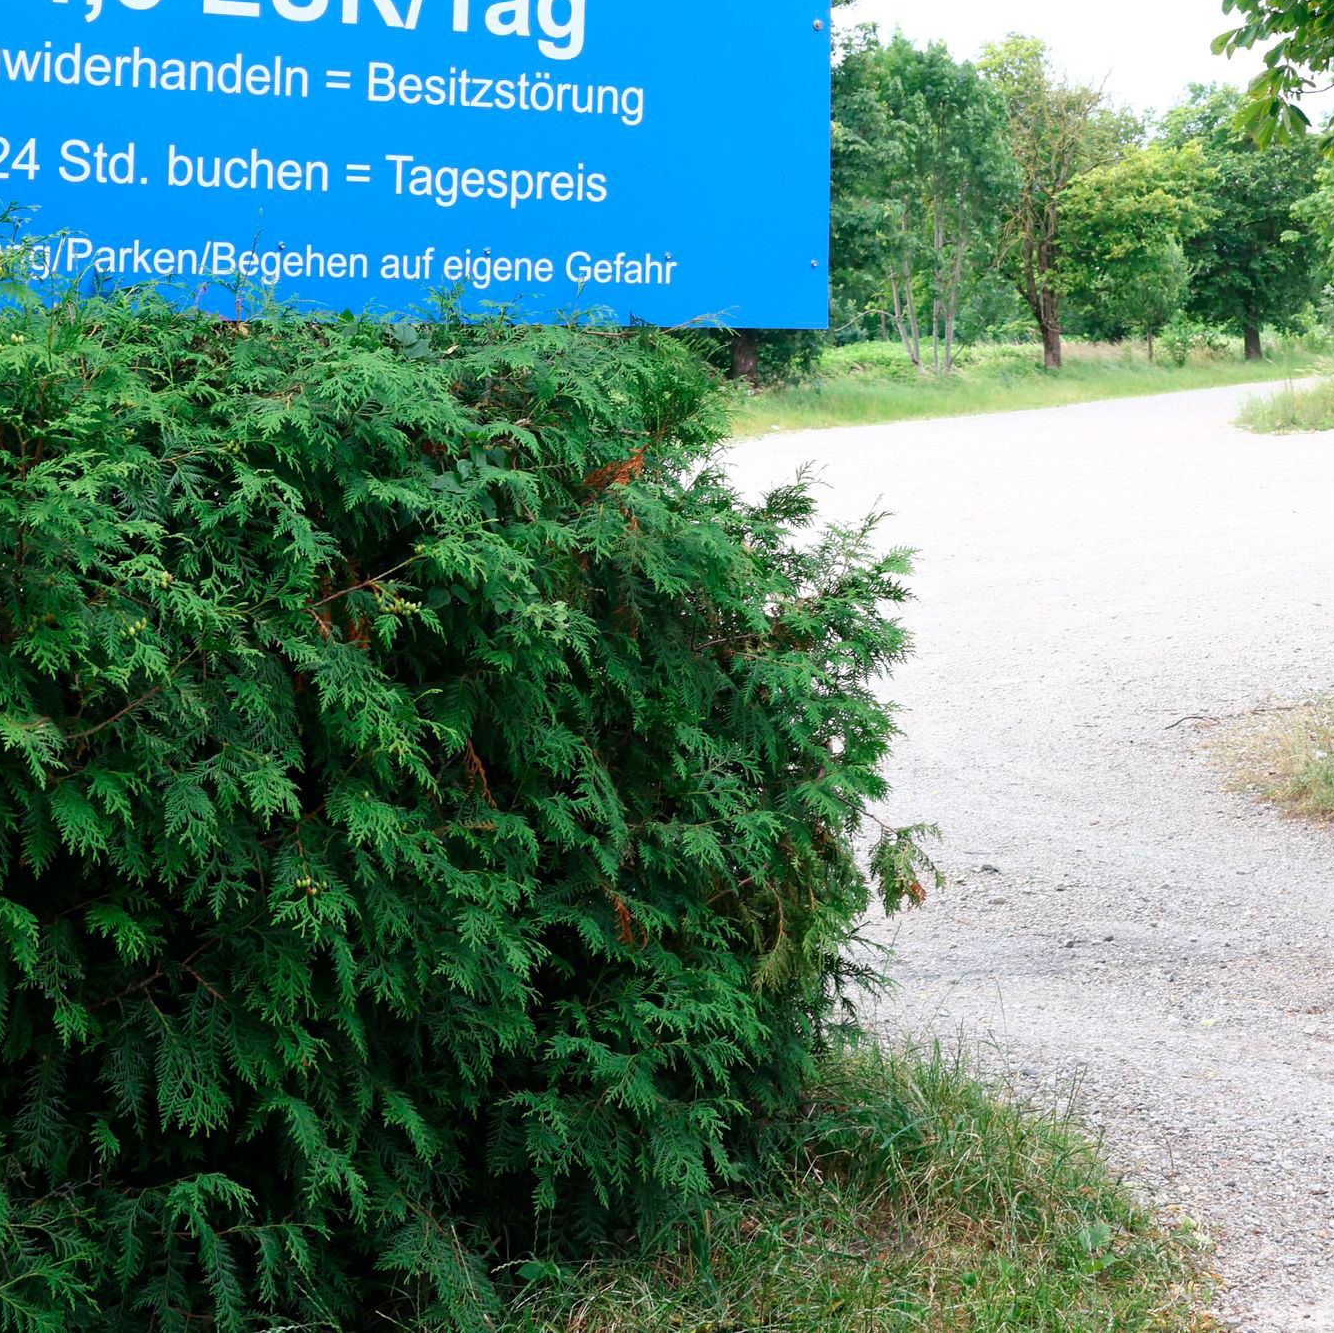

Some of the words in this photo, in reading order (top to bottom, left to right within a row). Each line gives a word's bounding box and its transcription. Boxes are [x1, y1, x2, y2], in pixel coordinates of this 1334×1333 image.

[367, 61, 644, 126] Besitzstörung
[58, 139, 149, 185] Std.
[168, 144, 329, 192] buchen
[385, 154, 608, 209] Tagespreis
[380, 247, 435, 280] auf
[443, 251, 554, 290] eigene
[565, 250, 678, 285] Gefahr
